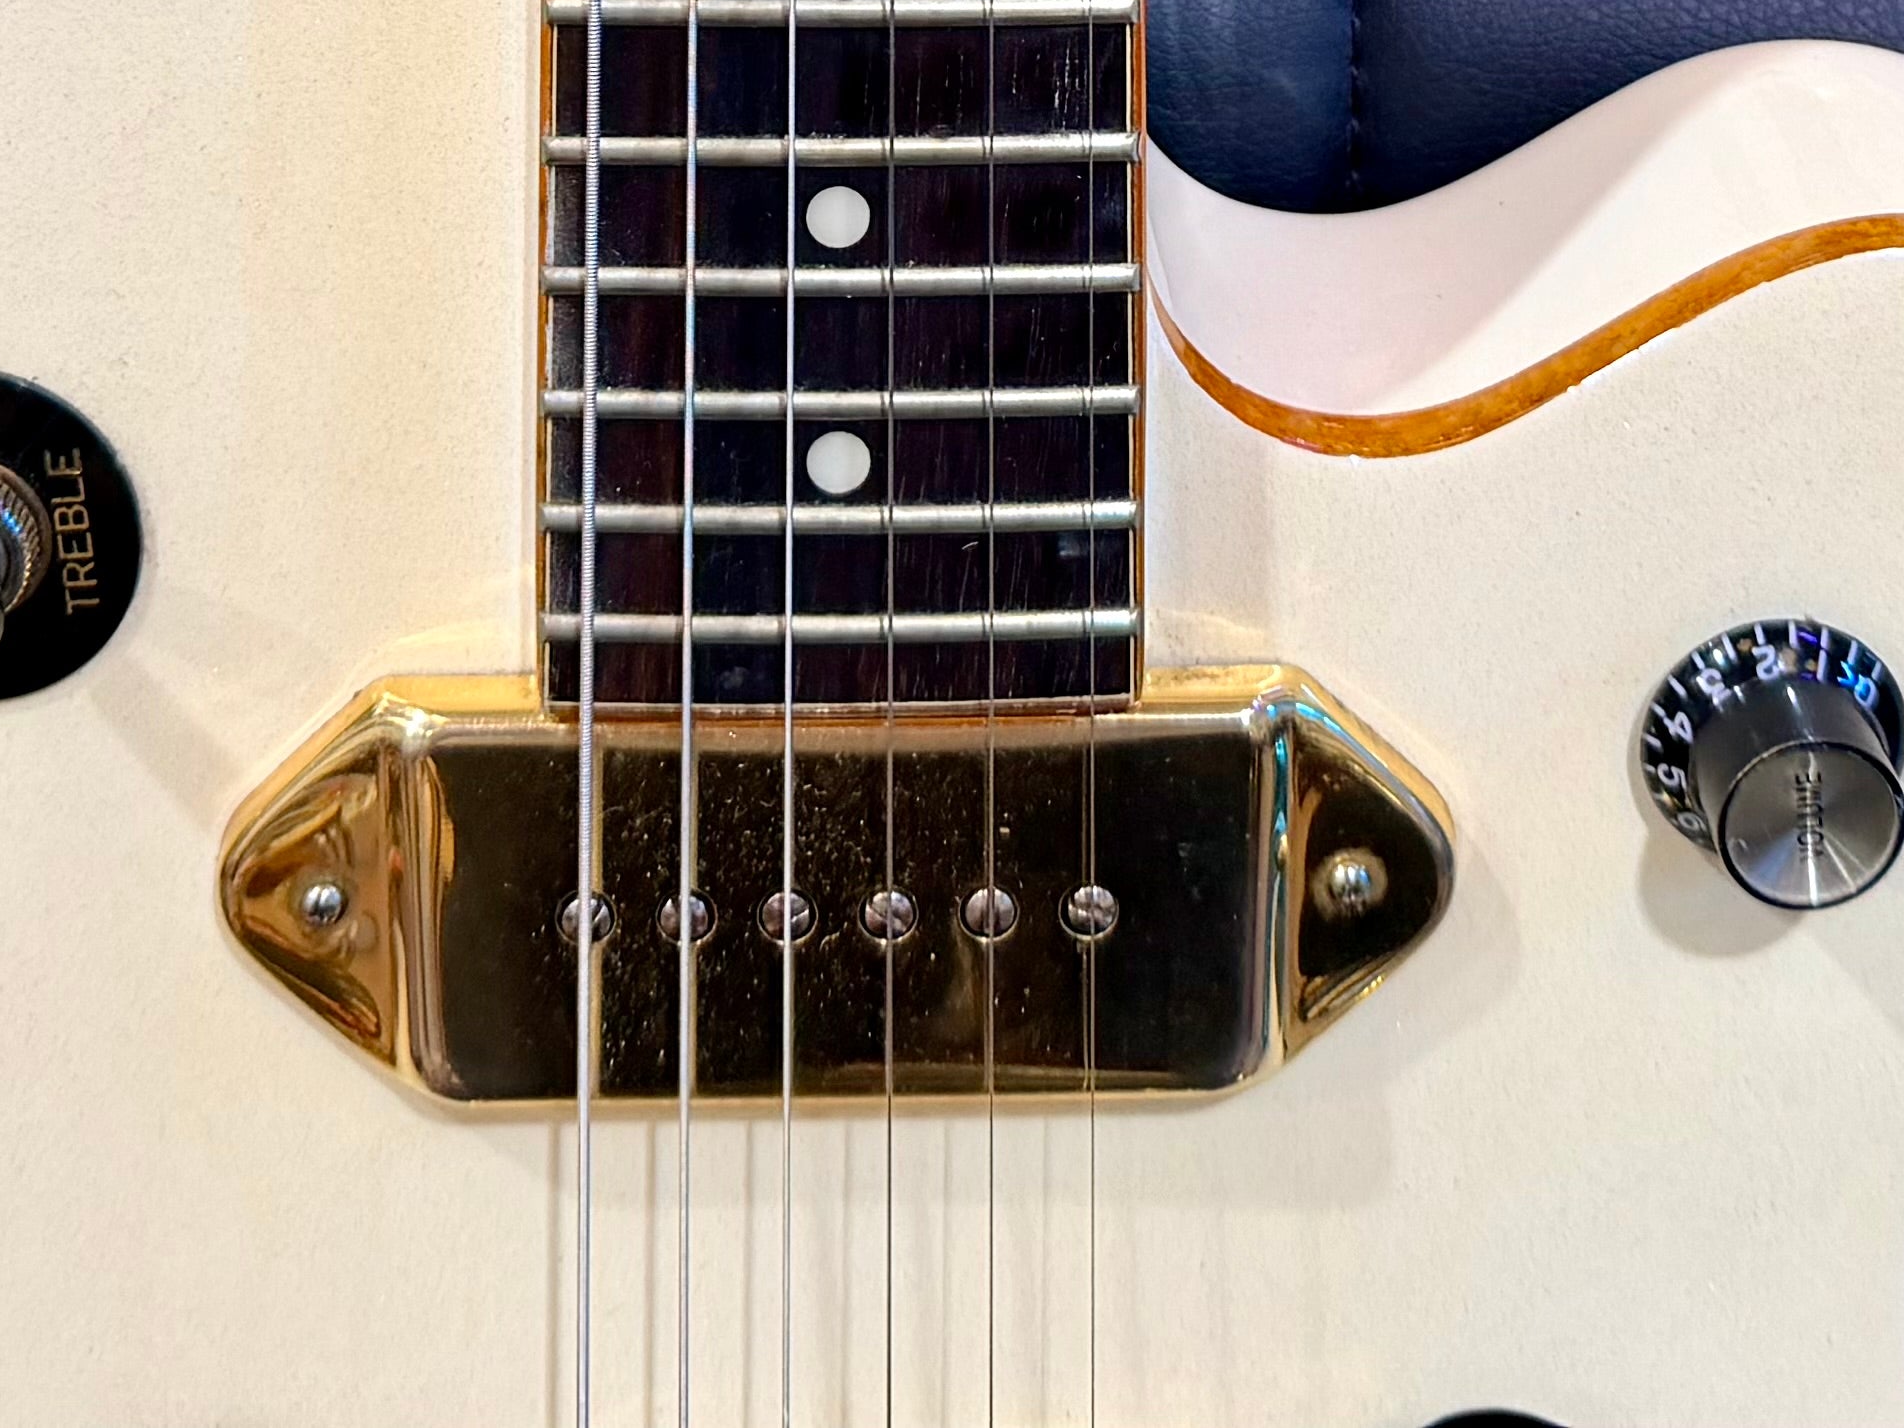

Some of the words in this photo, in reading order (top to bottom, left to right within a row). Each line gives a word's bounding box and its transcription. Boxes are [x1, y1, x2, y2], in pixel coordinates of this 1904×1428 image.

[44, 447, 99, 615] TREBLE
[1751, 644, 1780, 681] 2
[1663, 710, 1694, 745] 4
[1656, 761, 1686, 795] 5
